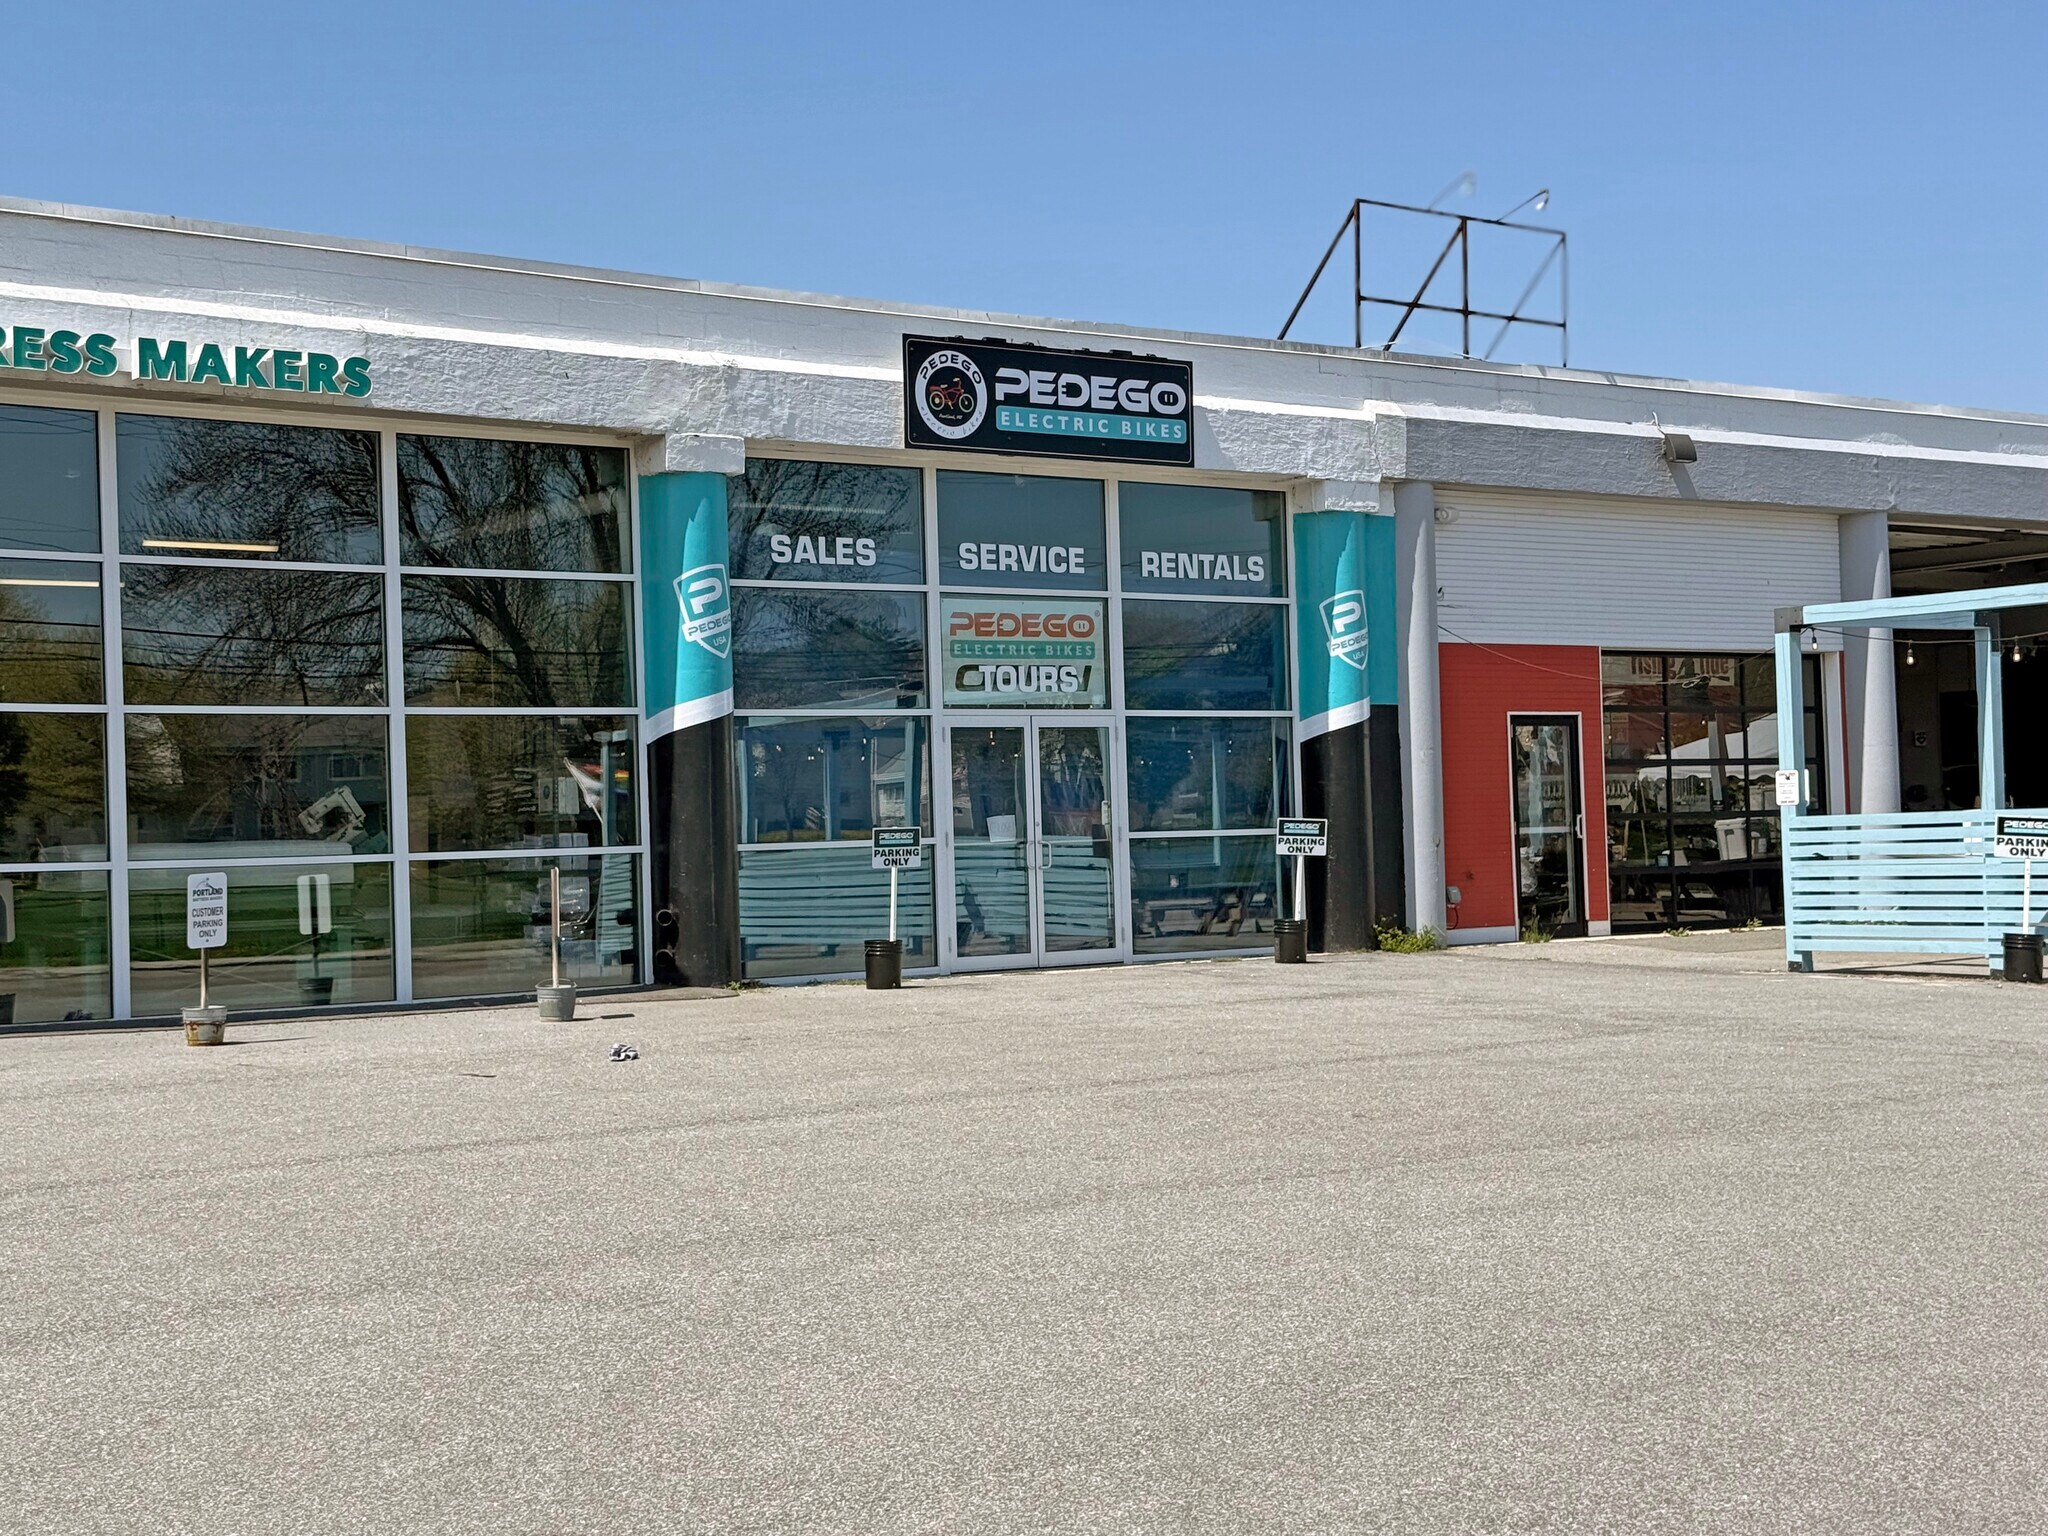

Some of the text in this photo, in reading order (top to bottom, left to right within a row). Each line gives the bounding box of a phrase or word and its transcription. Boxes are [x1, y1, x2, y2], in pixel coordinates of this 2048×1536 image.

[137, 336, 374, 399] MAKERS
[919, 353, 982, 385] PEDEGO
[995, 367, 1187, 415] PEDEGO
[1000, 411, 1183, 439] ELECTRIC BIKES
[770, 534, 877, 567] SALES
[958, 542, 1086, 575] SERVICE
[1141, 551, 1266, 583] RENTALS
[950, 612, 1095, 638] PEDEGO
[1332, 631, 1368, 652] PEDEG
[953, 643, 1093, 657] ELECTRIC BIKES
[978, 665, 1080, 693] TOURS
[1283, 822, 1320, 830] PEDEGO
[2003, 820, 2048, 829] PEDEGO
[878, 832, 914, 840] PEDEGO
[1277, 837, 1325, 846] PARKING
[1996, 837, 2048, 848] PARKIN
[874, 848, 920, 858] PARKING
[1287, 845, 1315, 854] ONLY
[2009, 847, 2047, 857] ONLY
[883, 857, 910, 867] ONLY
[191, 906, 224, 918] CUSTOMER
[192, 918, 224, 929] PARKING
[198, 929, 218, 938] ONLY
